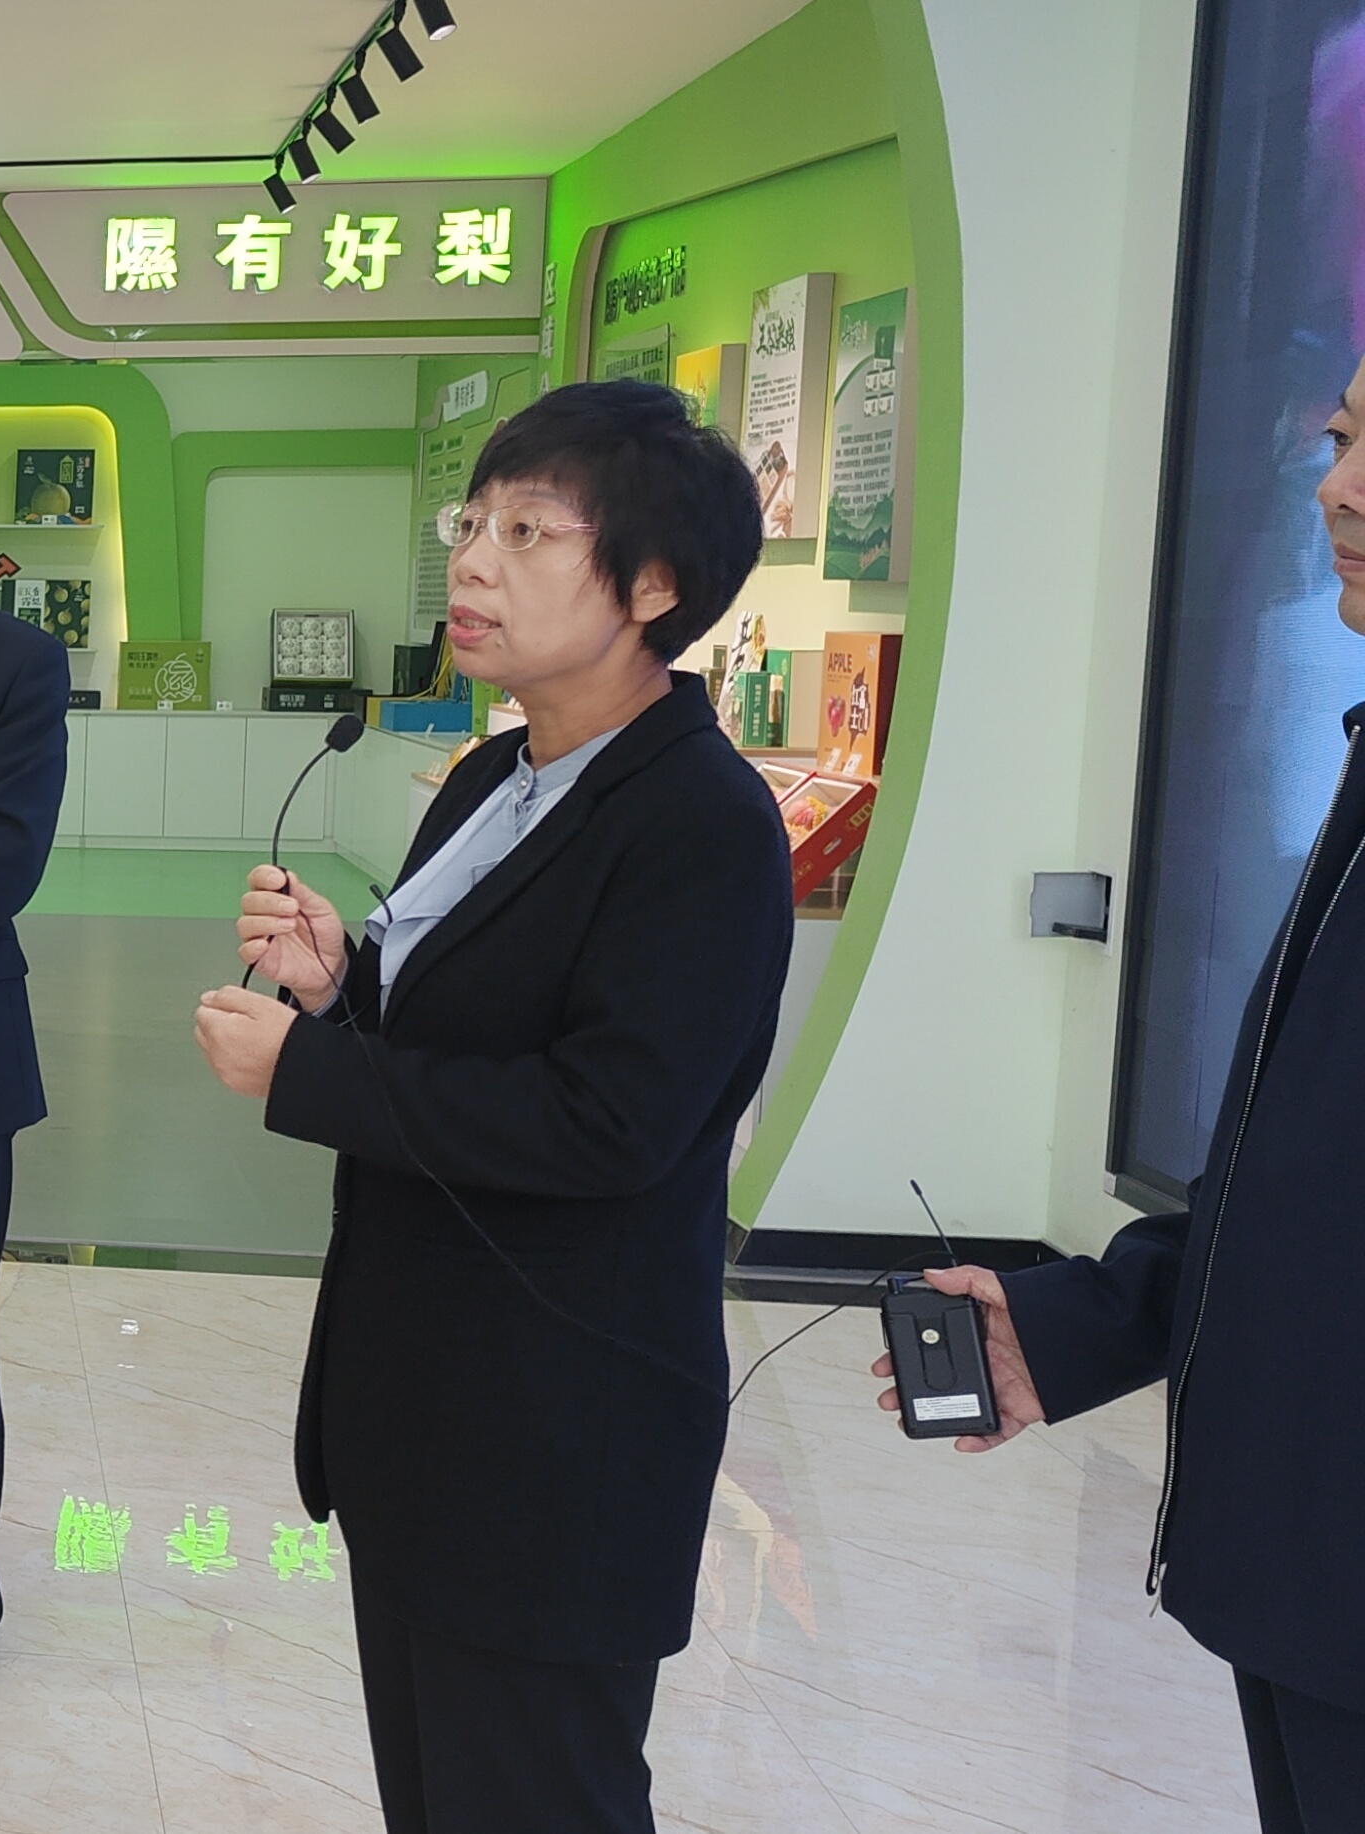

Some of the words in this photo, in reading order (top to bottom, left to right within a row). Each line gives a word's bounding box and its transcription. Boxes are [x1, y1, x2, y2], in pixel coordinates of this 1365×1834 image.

[104, 207, 512, 293] 隰有好梨
[827, 652, 853, 674] APPLE
